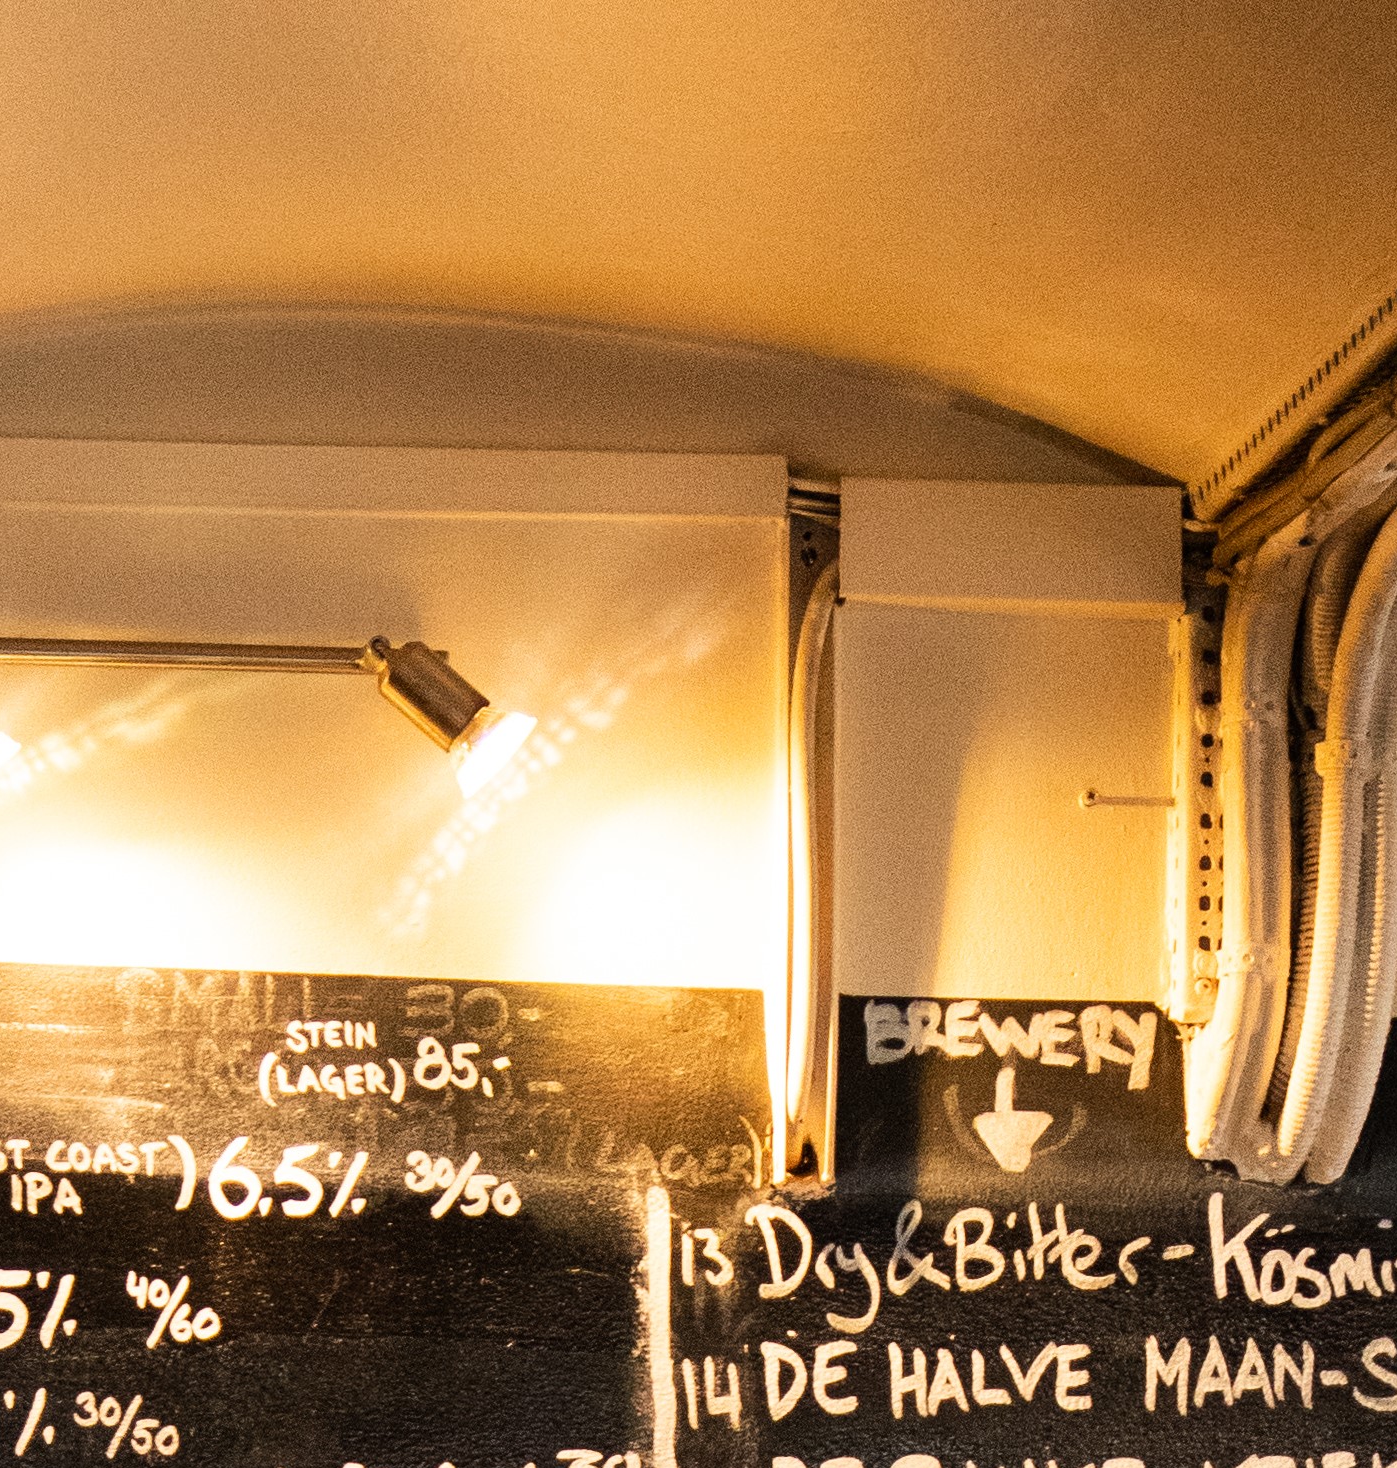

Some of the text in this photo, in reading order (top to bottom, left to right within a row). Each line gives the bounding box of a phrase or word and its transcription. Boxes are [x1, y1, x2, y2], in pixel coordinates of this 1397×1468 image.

[284, 1020, 378, 1052] STEIN
[864, 999, 1157, 1090] BREWERY
[46, 1138, 167, 1177] COAST
[10, 1172, 83, 1216] IPA
[761, 1340, 858, 1421] DE
[888, 1342, 1093, 1419] HALVE
